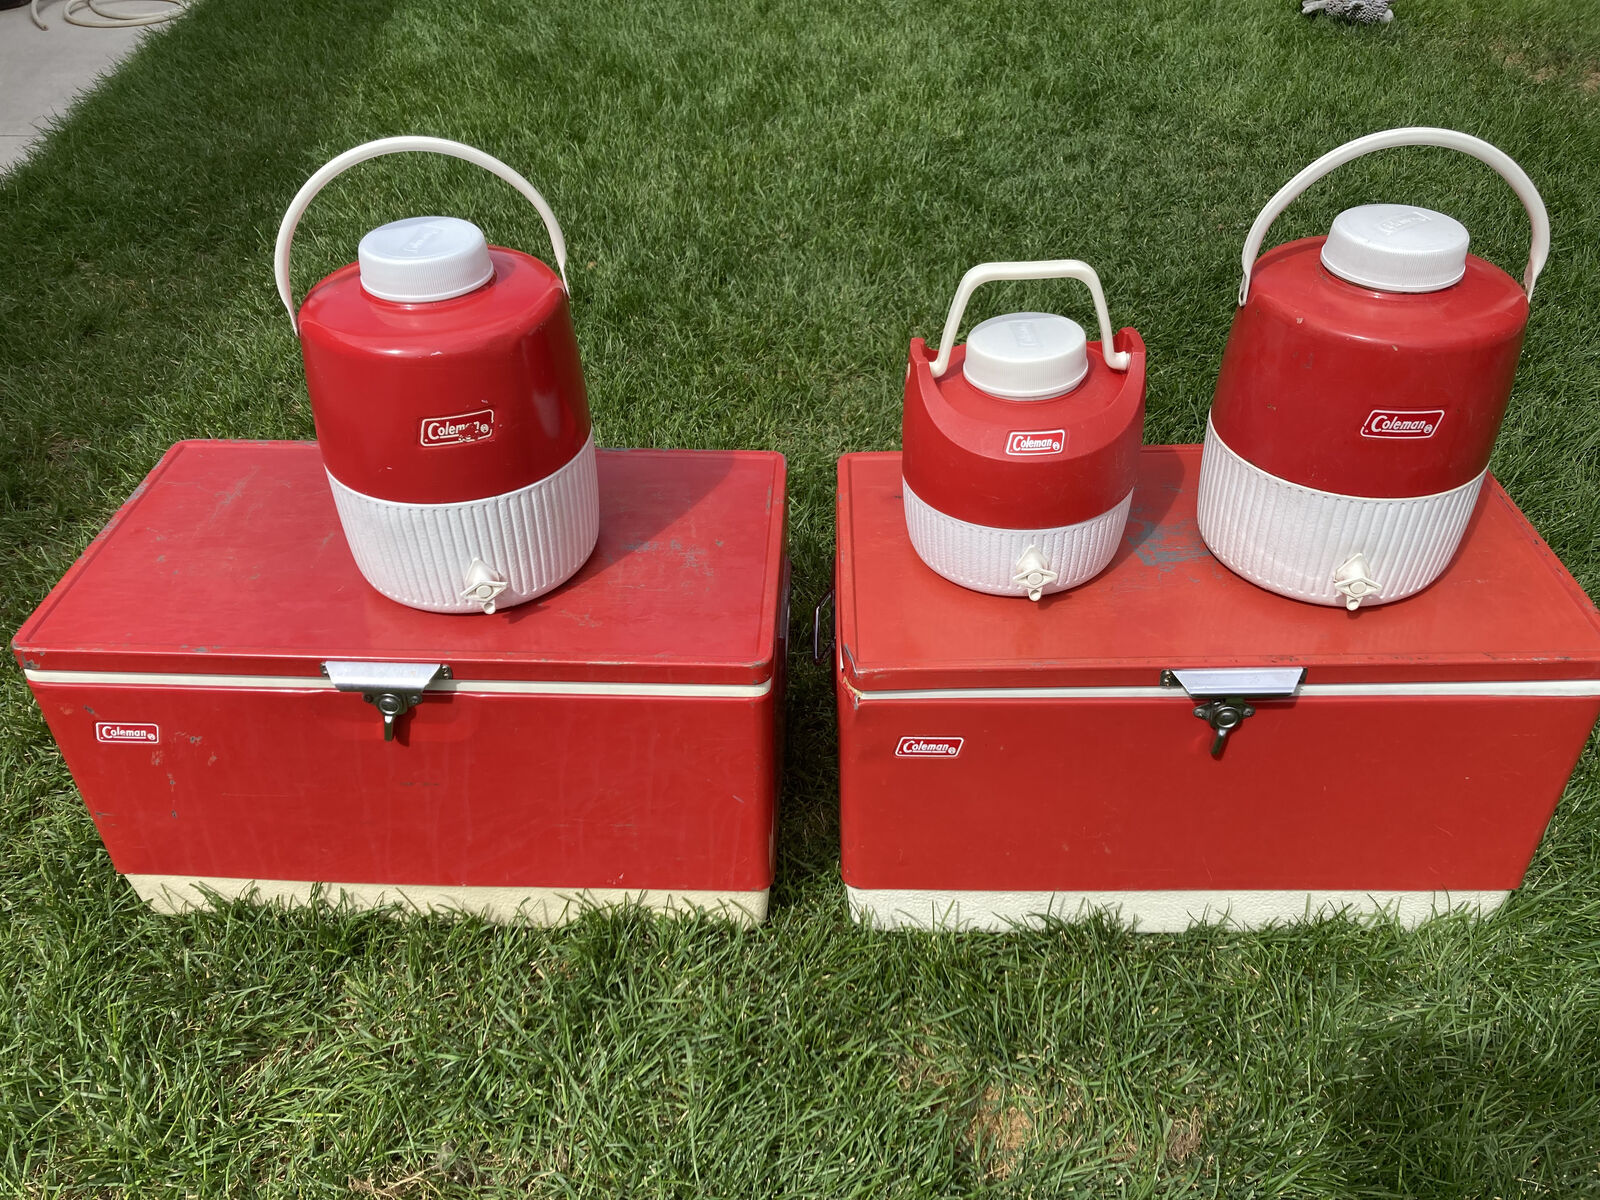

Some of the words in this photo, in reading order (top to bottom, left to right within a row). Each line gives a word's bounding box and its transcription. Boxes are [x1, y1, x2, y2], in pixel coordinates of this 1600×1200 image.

[1371, 415, 1426, 432] Coleman
[1013, 436, 1053, 451] Coleman
[102, 726, 146, 739] Coleman
[903, 740, 950, 753] Coleman
